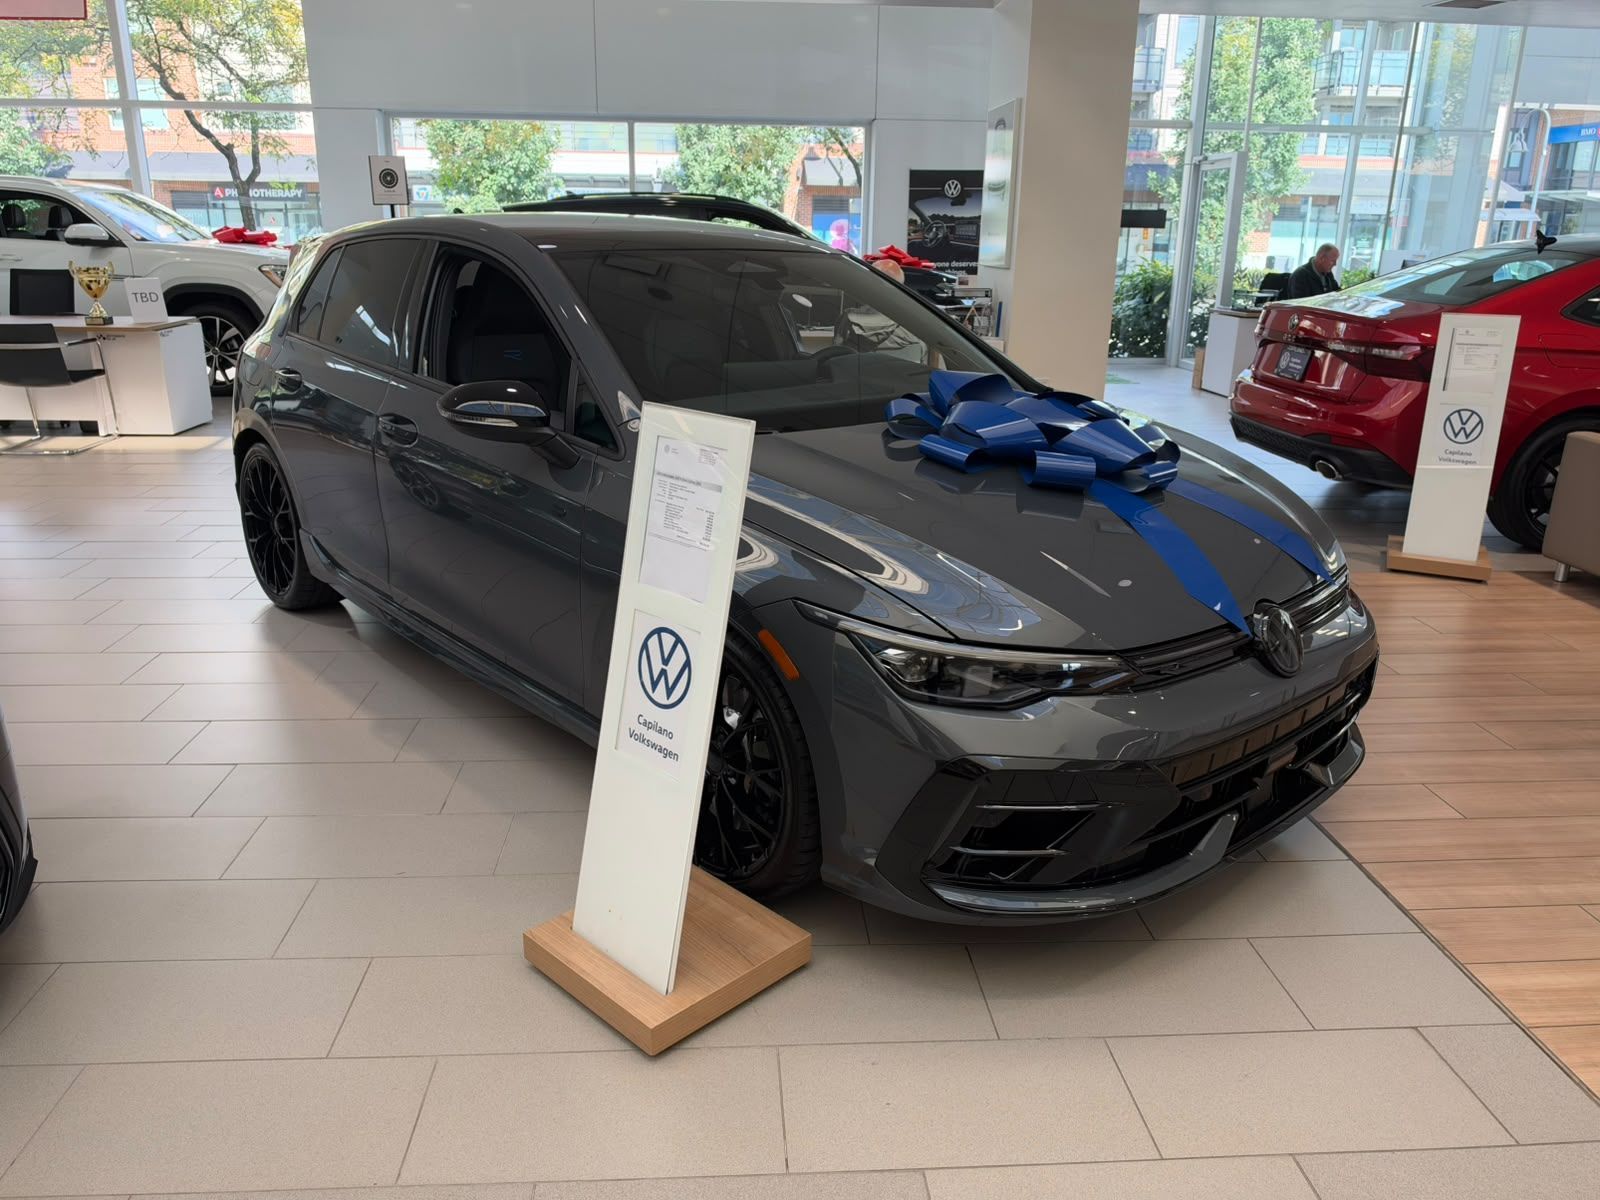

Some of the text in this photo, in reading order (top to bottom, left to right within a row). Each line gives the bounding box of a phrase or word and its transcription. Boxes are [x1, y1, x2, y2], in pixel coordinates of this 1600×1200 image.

[225, 188, 303, 198] PHIOTHERAPY
[131, 291, 159, 303] TBD
[1443, 408, 1484, 445] VW
[1444, 449, 1472, 457] Capilano
[638, 626, 692, 710] VW
[637, 714, 674, 740] Capilano
[628, 728, 679, 762] Volkswagen
